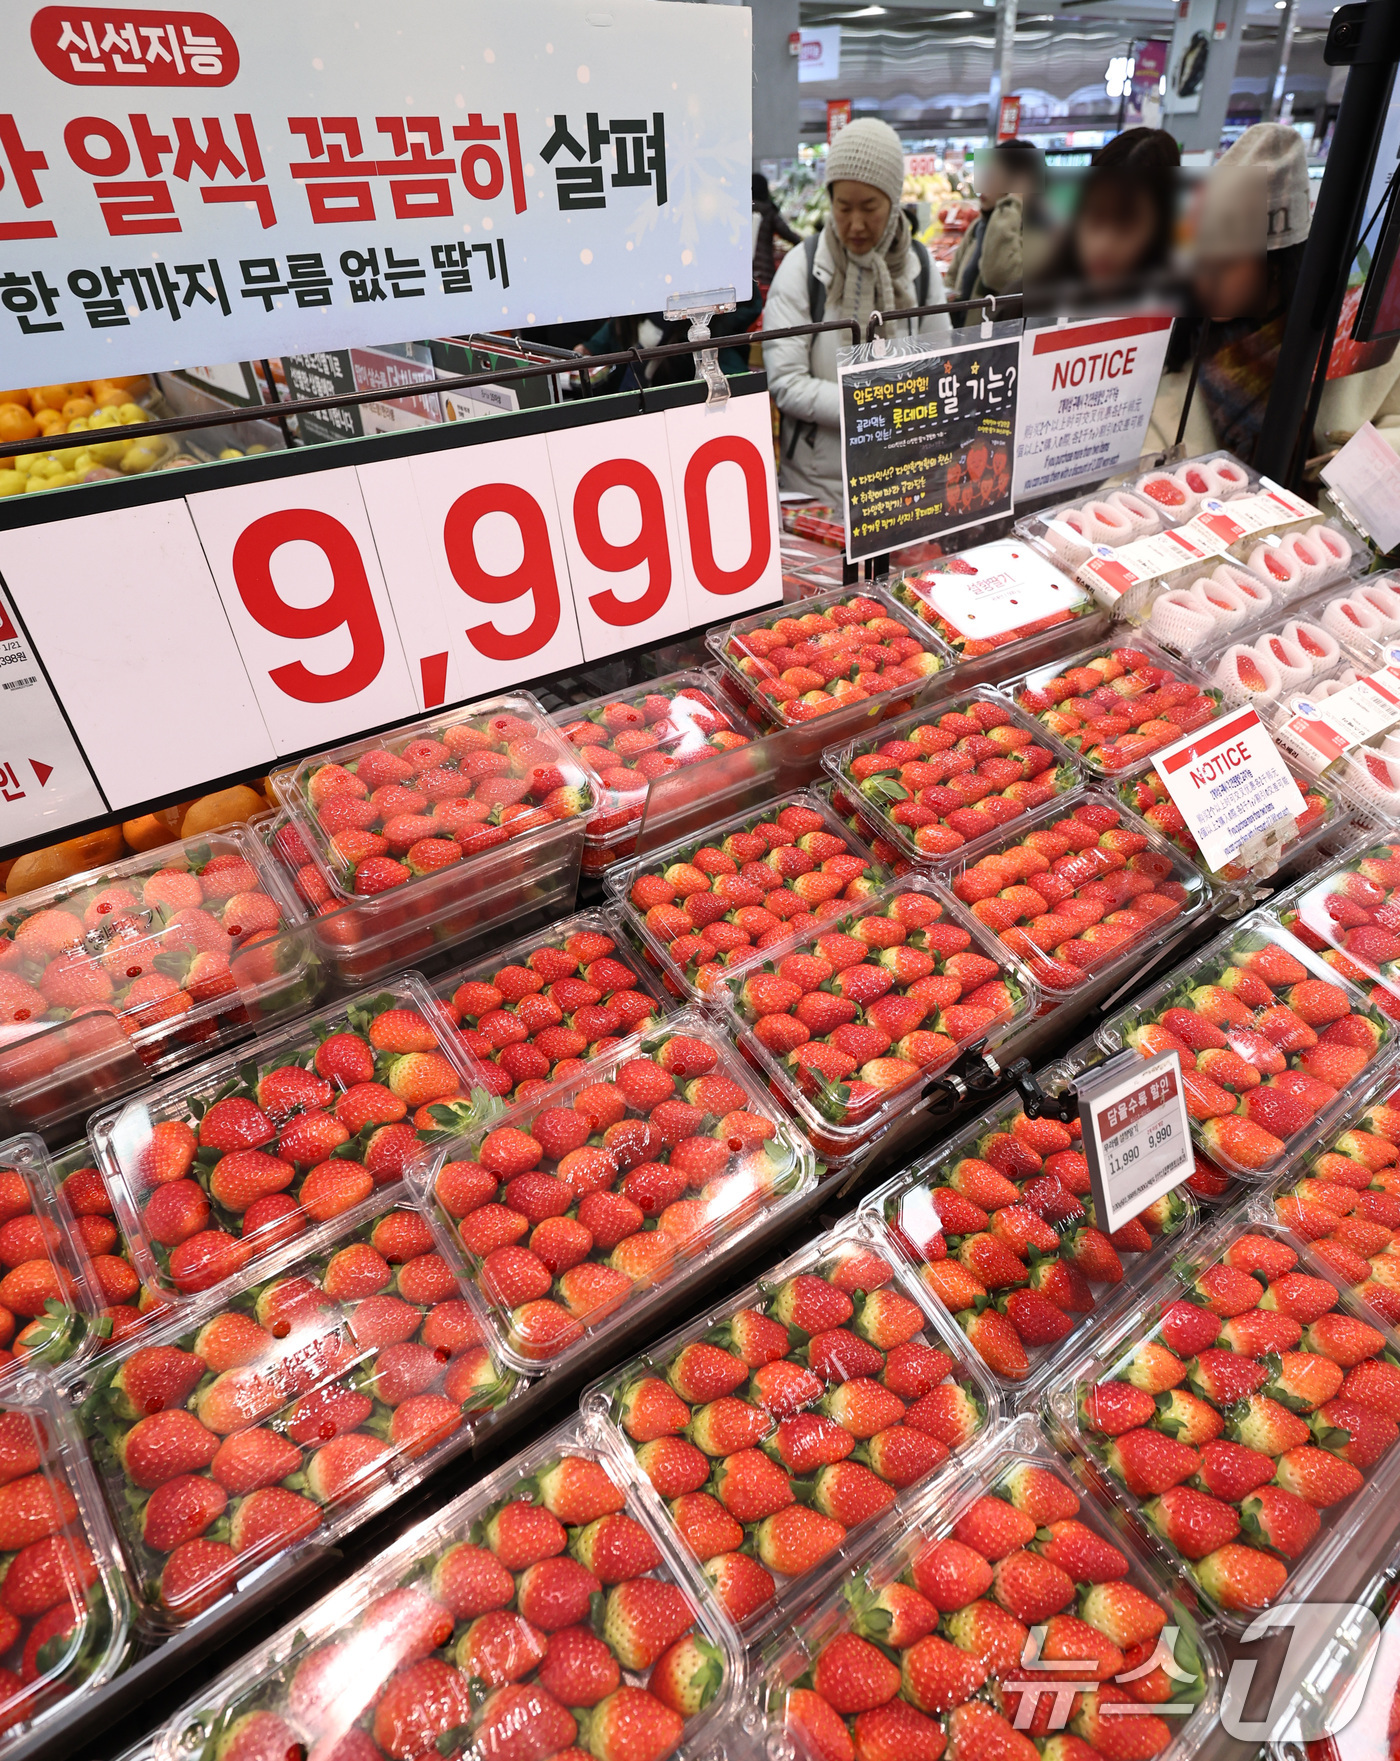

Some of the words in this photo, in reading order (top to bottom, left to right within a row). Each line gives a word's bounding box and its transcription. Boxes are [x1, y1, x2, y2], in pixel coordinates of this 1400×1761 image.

[56, 20, 223, 75] 신선지능
[63, 113, 278, 237] 알씩
[288, 112, 528, 225] 꼼꼼히
[540, 112, 669, 211] 살펴
[0, 271, 64, 334] 한
[67, 258, 232, 329] 알까지
[240, 252, 333, 309] 무름
[340, 247, 426, 303] 없는
[432, 238, 511, 295] 딸기
[1052, 346, 1138, 392] NOTICE
[853, 384, 894, 406] 압도적인
[896, 377, 929, 394] 다양함!
[856, 415, 886, 432] 골라먹는
[893, 401, 938, 429] 롯데마트
[849, 433, 874, 446] 재미가
[232, 435, 772, 710] 9,990
[966, 572, 1016, 595] 설향딸기
[2, 641, 21, 651] 1/21
[1275, 737, 1299, 759] 킹스베리
[1189, 741, 1252, 790] NOTICE
[1107, 1089, 1148, 1128] 담을수록
[1149, 1076, 1170, 1101] 할인
[1148, 1124, 1172, 1149] 9,990
[1109, 1145, 1140, 1175] 11,990
